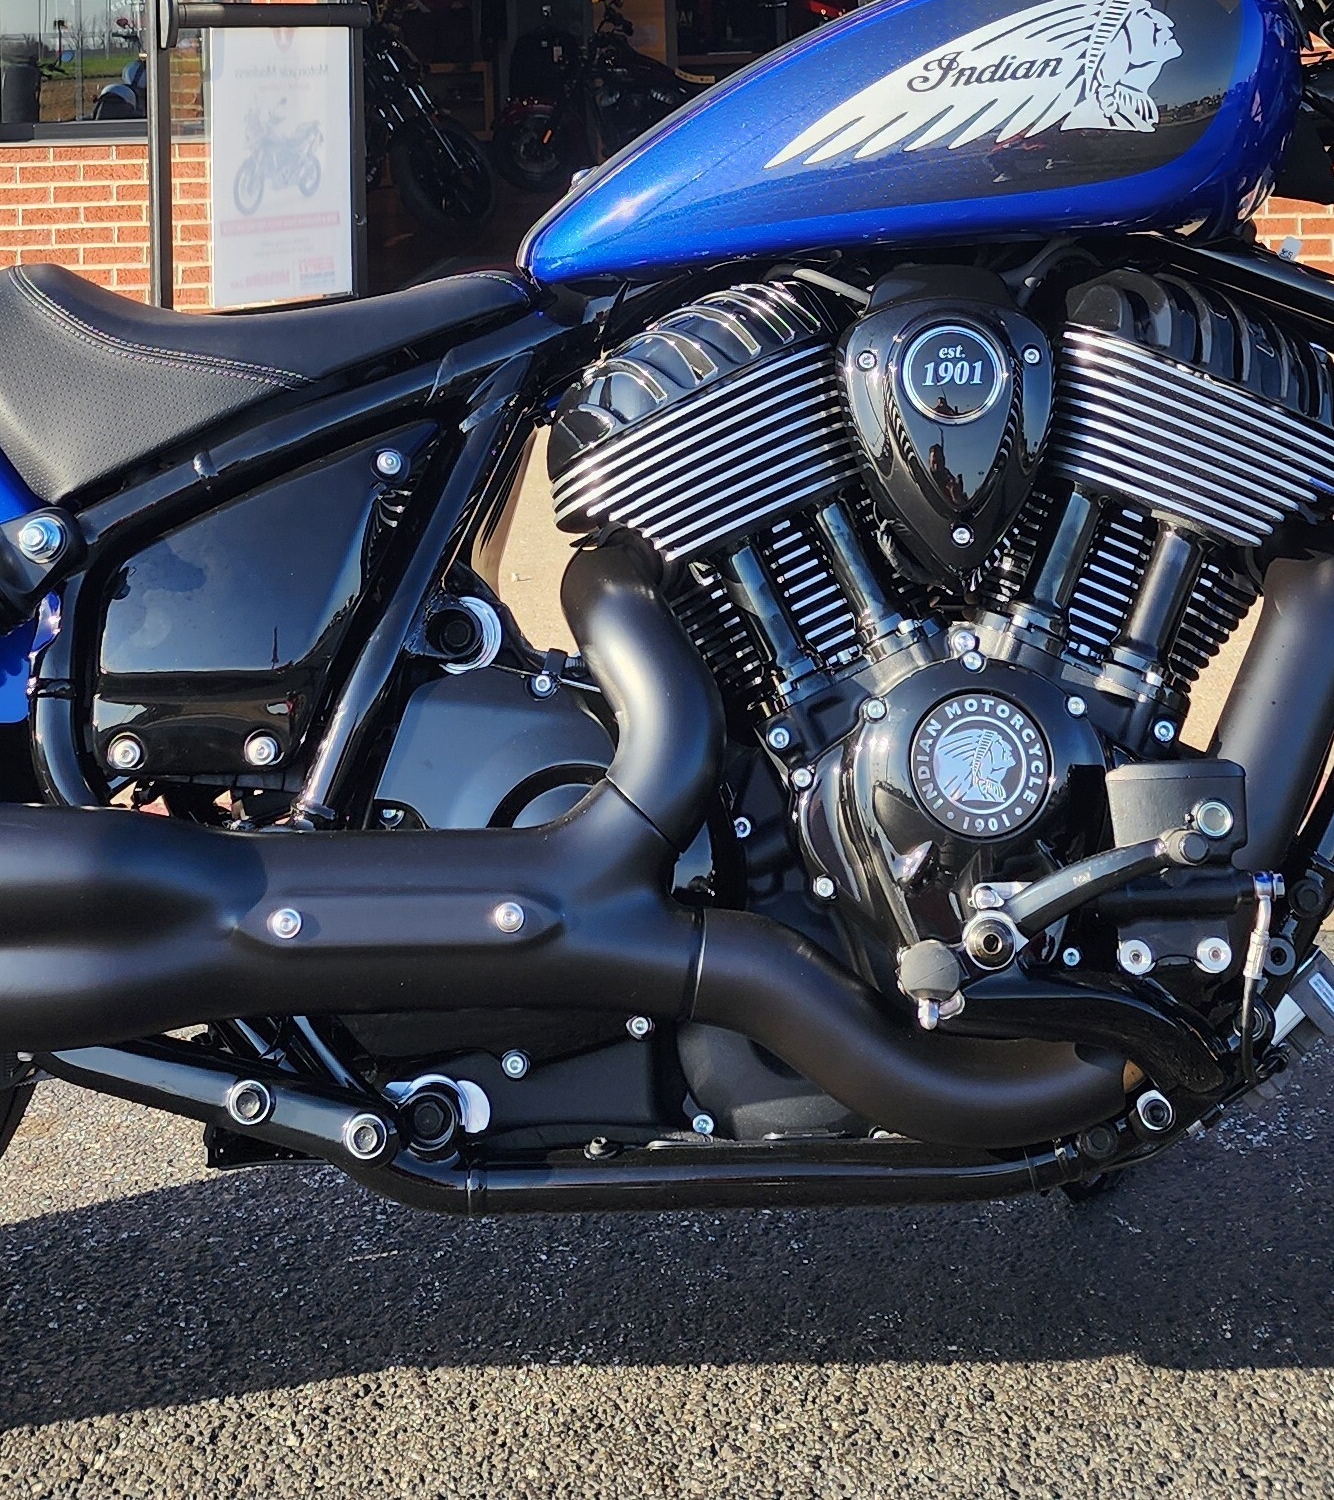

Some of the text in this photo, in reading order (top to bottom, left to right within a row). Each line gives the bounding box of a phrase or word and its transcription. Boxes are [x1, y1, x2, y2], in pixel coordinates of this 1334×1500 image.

[908, 51, 1063, 93] Indian
[938, 344, 965, 359] est.
[922, 360, 983, 387] 1901
[917, 698, 1044, 811] INDIAN MOTORCYCLE
[962, 813, 1011, 832] 1901
